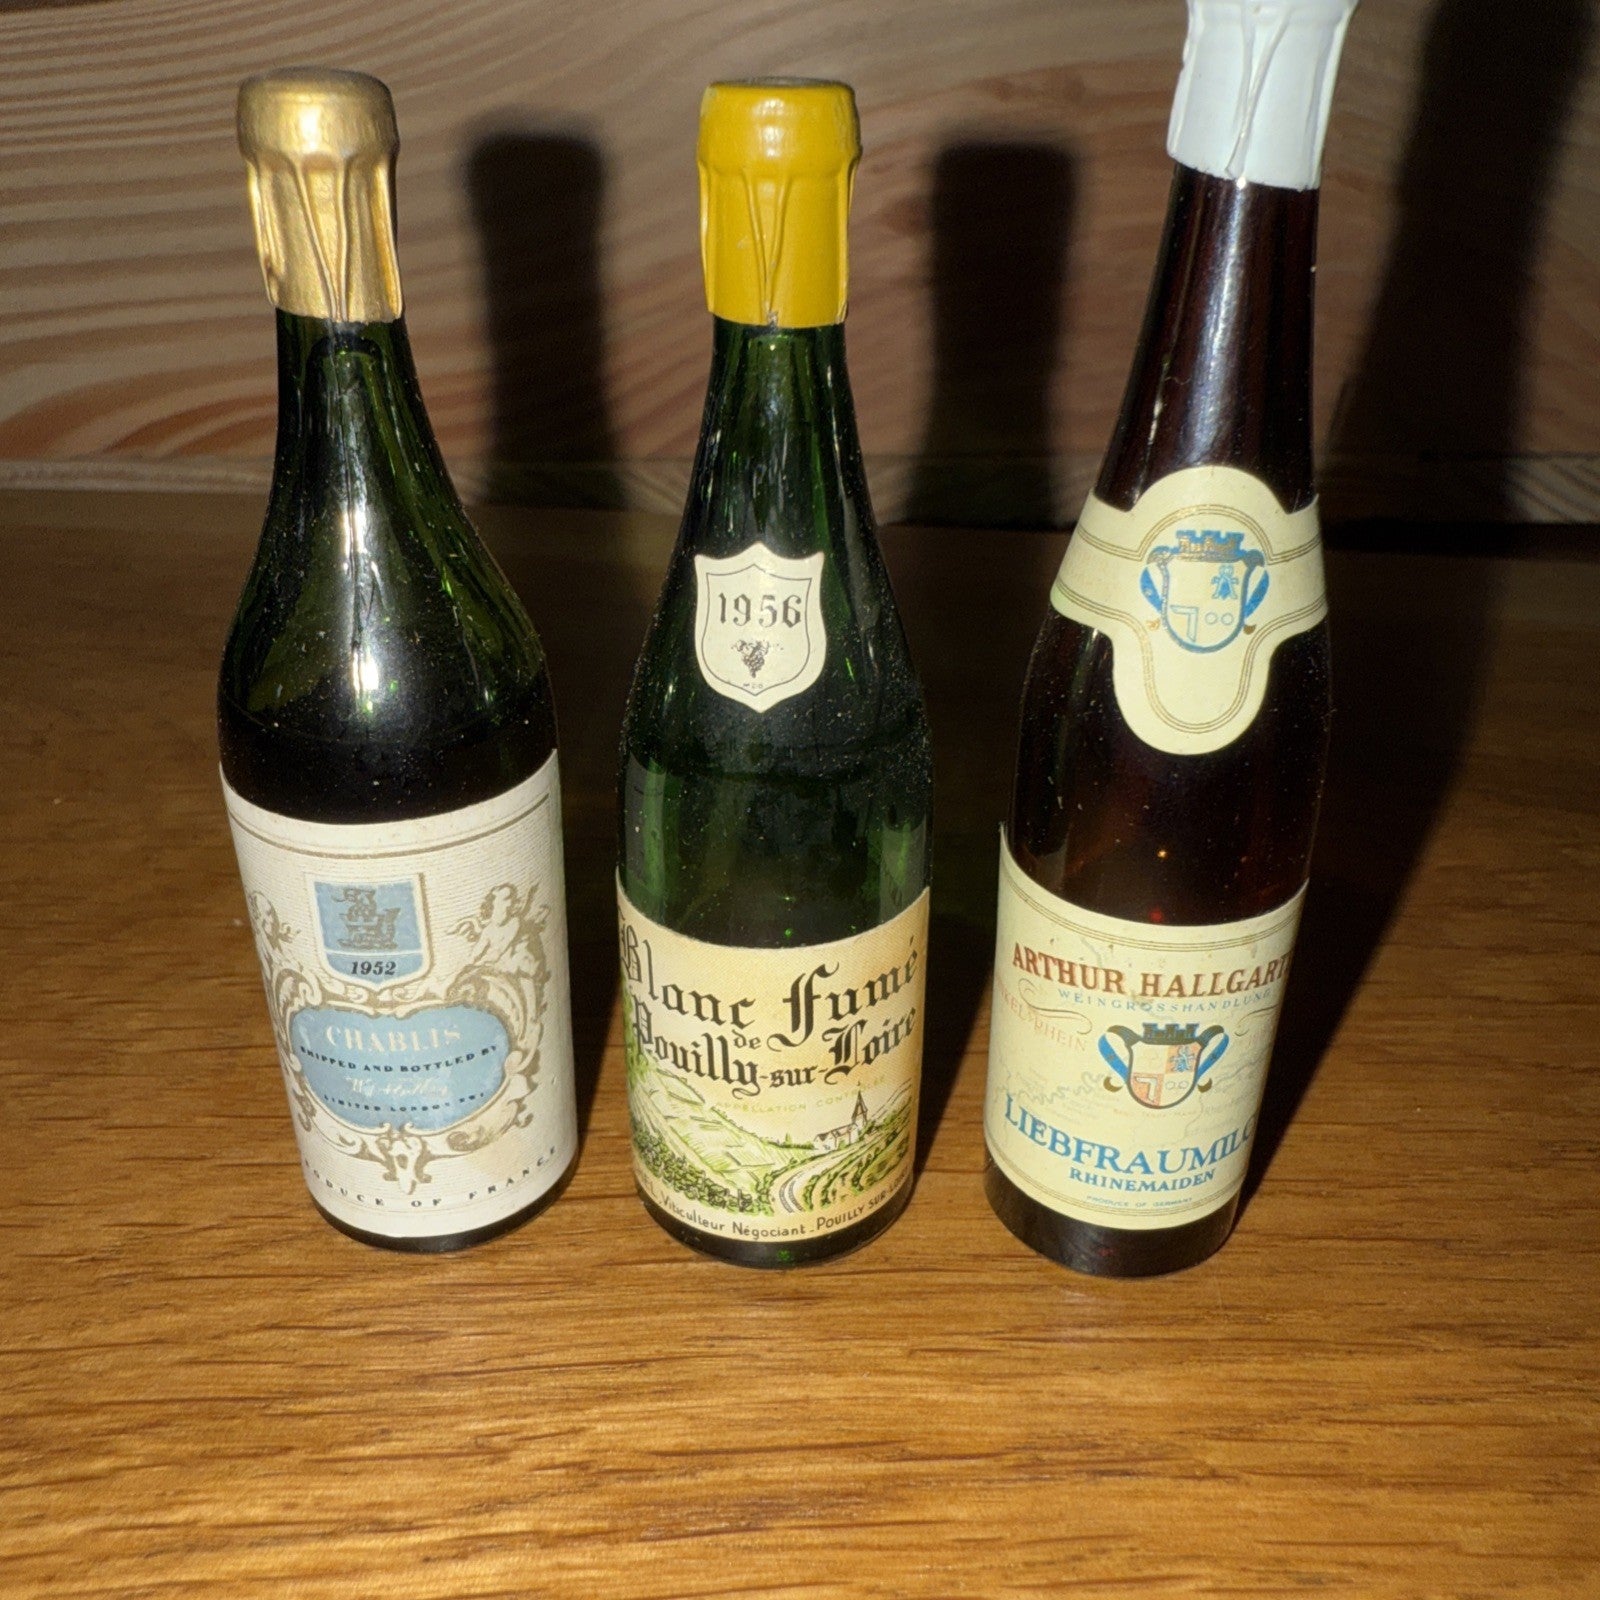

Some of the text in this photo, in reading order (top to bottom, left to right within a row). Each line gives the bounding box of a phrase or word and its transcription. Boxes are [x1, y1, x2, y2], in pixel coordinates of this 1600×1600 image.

[718, 592, 802, 629] 1956
[350, 960, 397, 976] 1952
[1012, 941, 1127, 995] ARTHUR
[621, 924, 918, 1053] Blanc Fumé
[1057, 988, 1272, 1013] WEINGROSSHANDLUNG
[325, 1025, 462, 1052] CHABLIS
[732, 1029, 762, 1050] de
[300, 1045, 498, 1073] SHIPPED AND BOTTLED BY
[410, 1198, 443, 1208] OF
[469, 1145, 556, 1201] FRANCE
[1069, 1166, 1216, 1193] RHINEMAIDEN
[732, 1221, 807, 1241] Négociant
[816, 1204, 865, 1232] POUILLY
